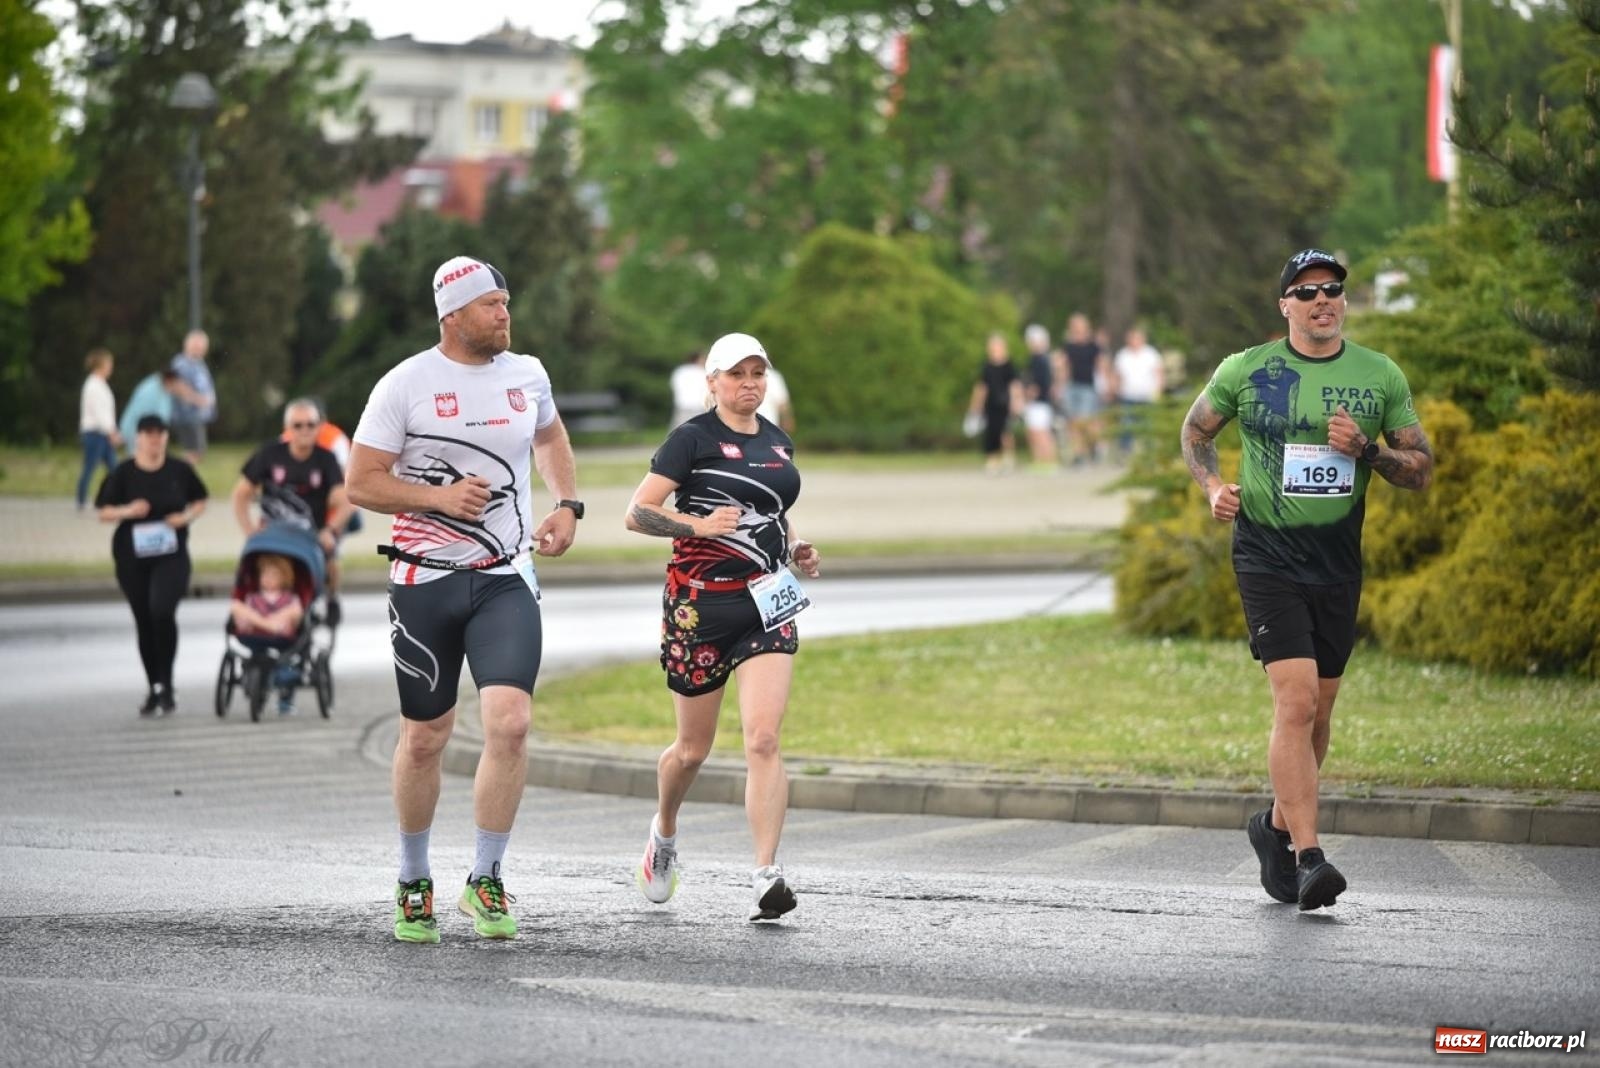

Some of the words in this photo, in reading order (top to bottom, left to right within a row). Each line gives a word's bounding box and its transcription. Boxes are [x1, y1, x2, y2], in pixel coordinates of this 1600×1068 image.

[1321, 386, 1375, 401] PYRA
[1322, 399, 1381, 415] TRAIL
[1302, 466, 1338, 483] 169
[770, 585, 797, 612] 256
